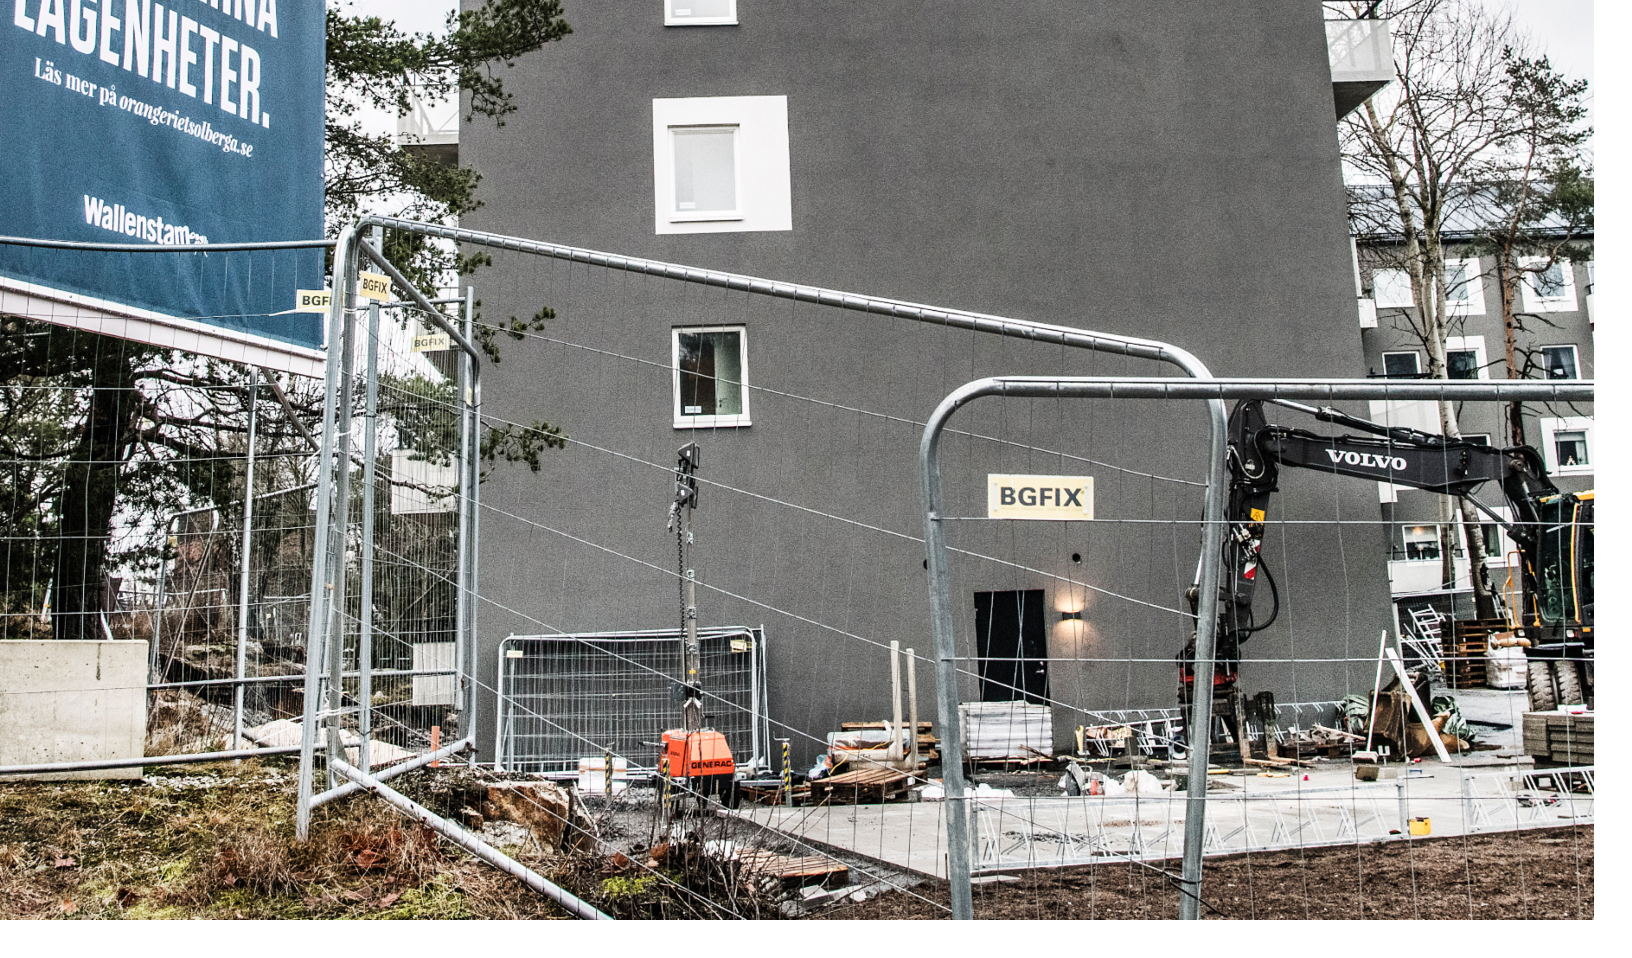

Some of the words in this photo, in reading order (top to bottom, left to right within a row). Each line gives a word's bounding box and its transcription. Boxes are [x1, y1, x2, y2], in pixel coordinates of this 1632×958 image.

[34, 57, 62, 85] Läs
[65, 73, 97, 98] mer
[99, 84, 117, 107] på
[119, 95, 253, 158] orangerietsolberga.se
[84, 194, 191, 245] Wallenstam
[362, 277, 388, 295] BGFIX
[414, 338, 445, 348] BGFIX
[1325, 448, 1407, 471] VOLVO
[1000, 486, 1083, 507] BGFIX
[691, 760, 732, 769] GENERAC
